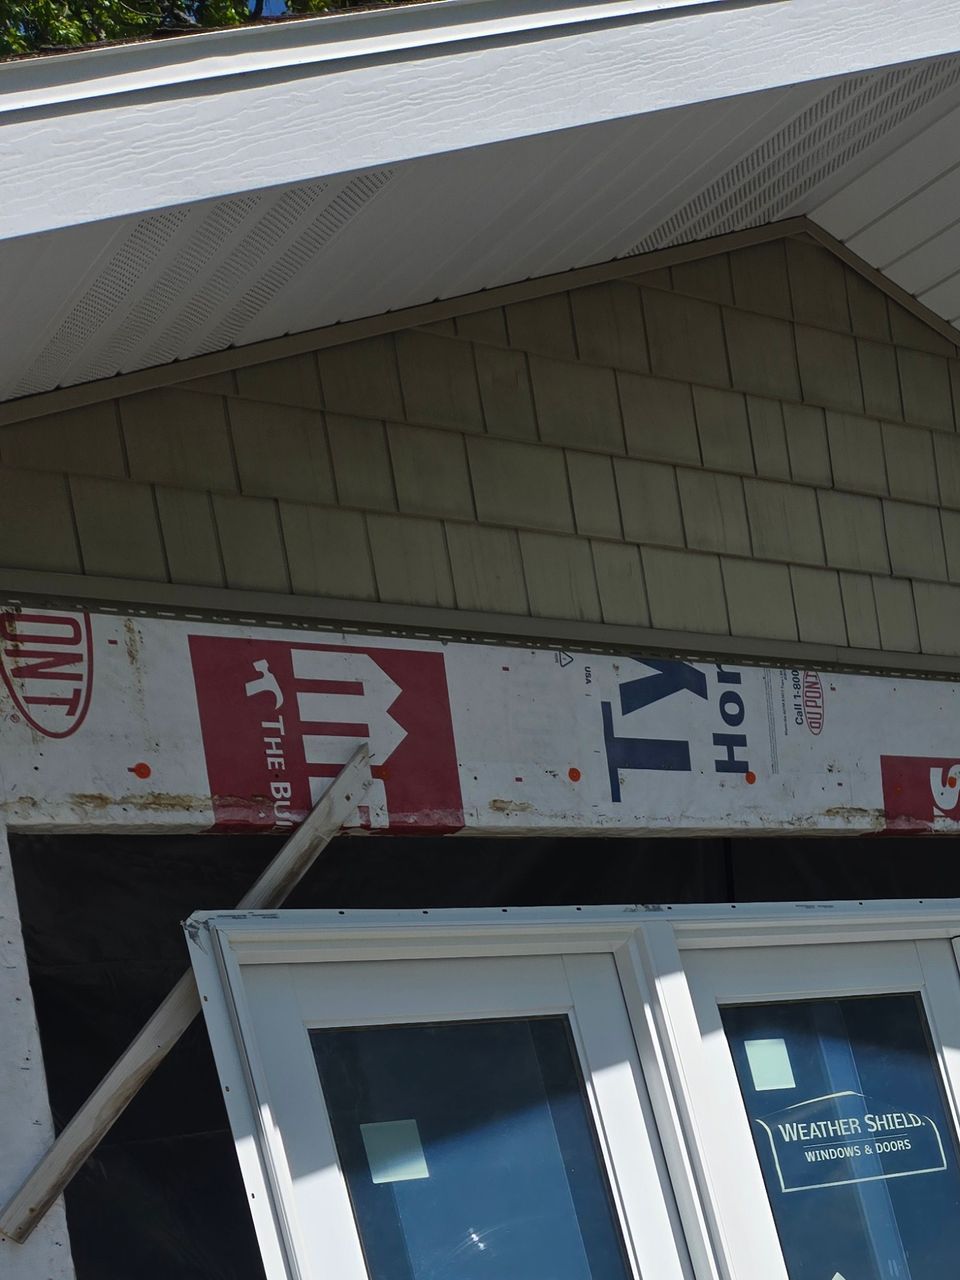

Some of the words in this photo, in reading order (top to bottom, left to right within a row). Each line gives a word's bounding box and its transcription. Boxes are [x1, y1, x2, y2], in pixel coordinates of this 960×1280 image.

[584, 666, 592, 685] USA
[792, 703, 804, 726] Call
[260, 715, 286, 770] THE
[777, 1117, 862, 1143] WEATHER
[804, 1145, 861, 1163] WINDOWS
[864, 1144, 874, 1155] &
[874, 1138, 912, 1154] DOORS
